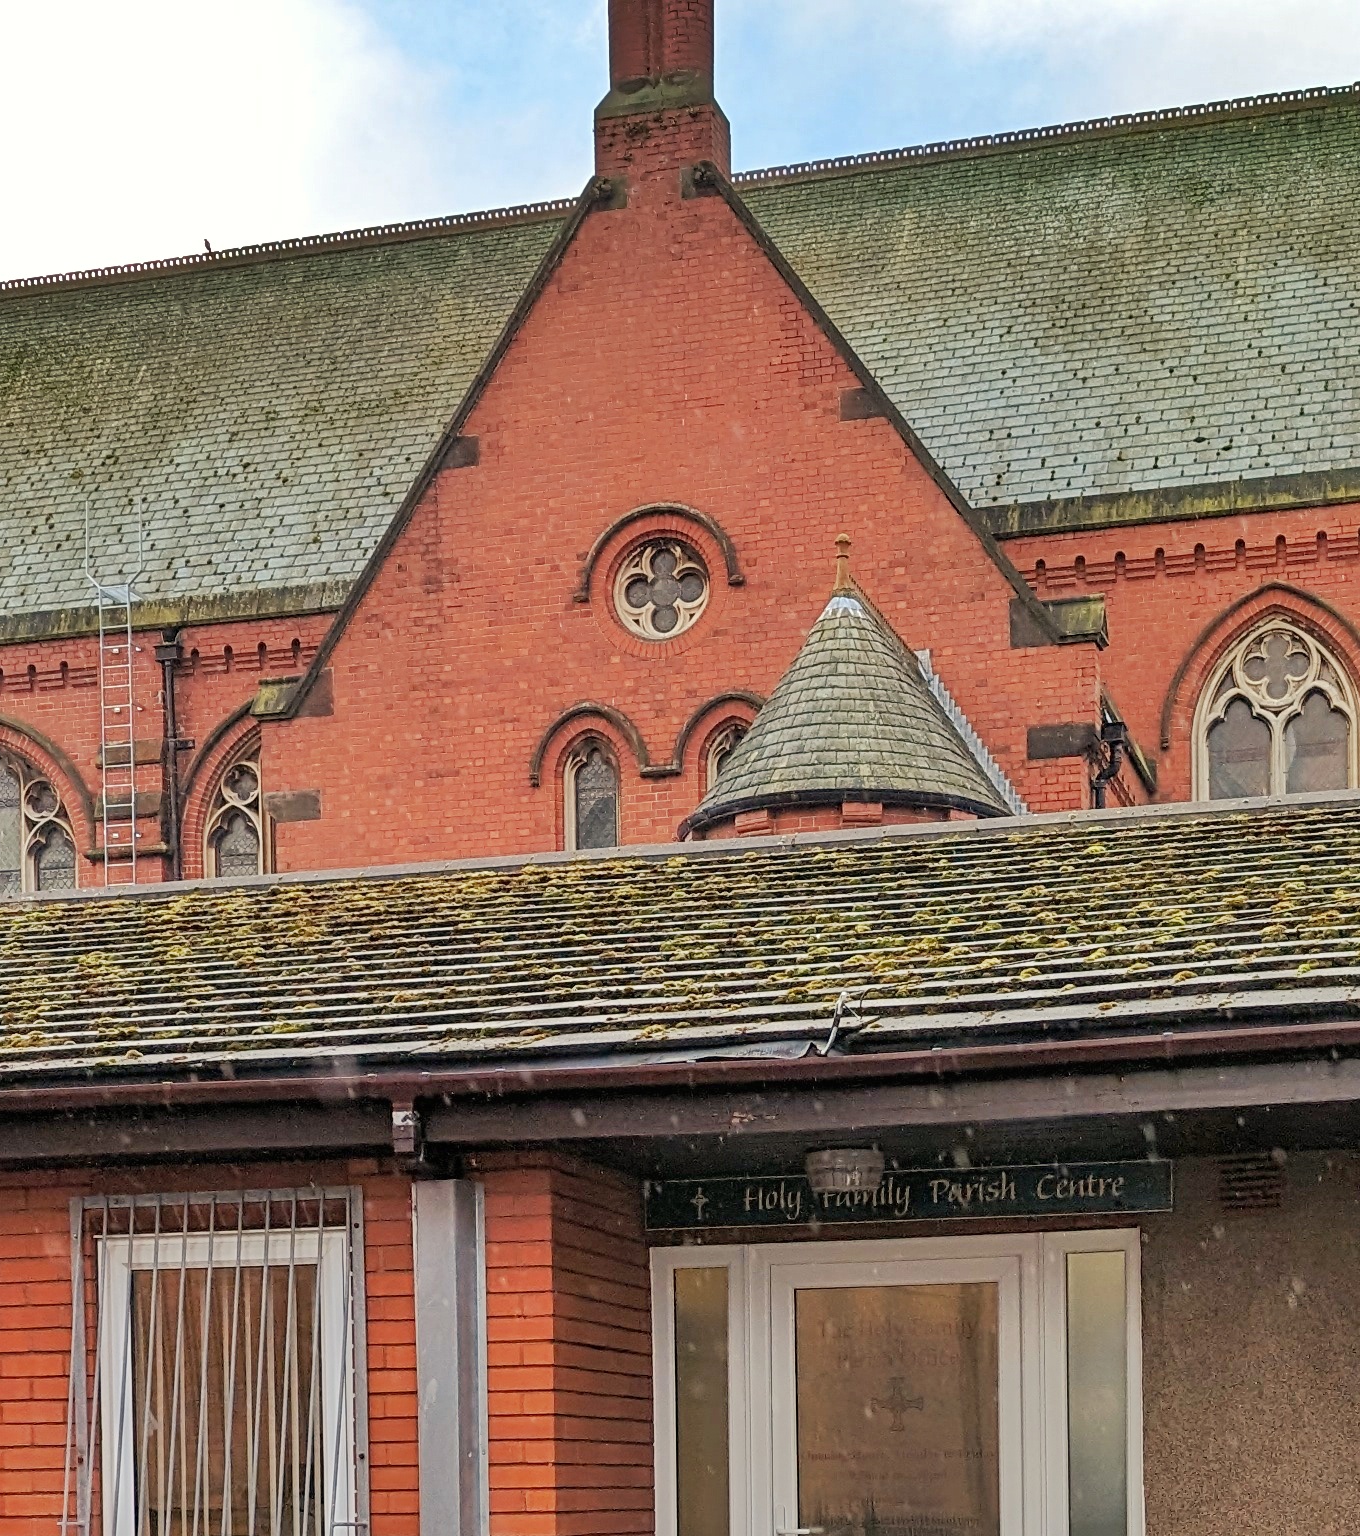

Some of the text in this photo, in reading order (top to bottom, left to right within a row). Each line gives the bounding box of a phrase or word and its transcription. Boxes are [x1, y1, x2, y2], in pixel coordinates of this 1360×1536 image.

[744, 1181, 801, 1220] Holy
[929, 1171, 1016, 1204] Parish
[1036, 1173, 1125, 1201] Centre
